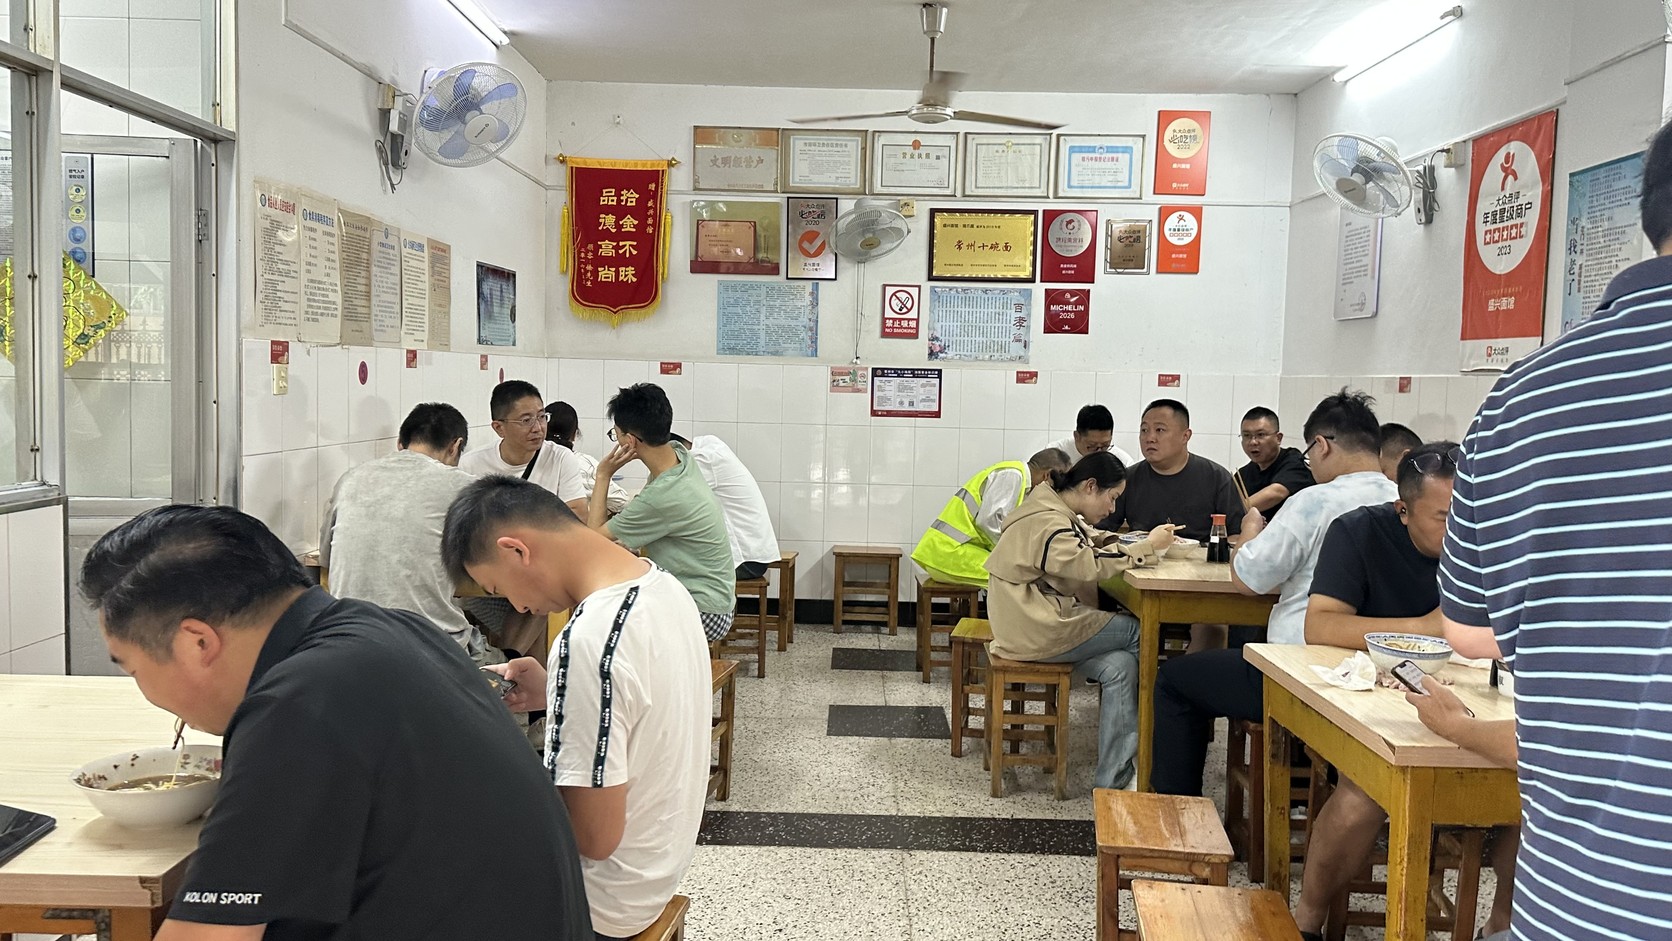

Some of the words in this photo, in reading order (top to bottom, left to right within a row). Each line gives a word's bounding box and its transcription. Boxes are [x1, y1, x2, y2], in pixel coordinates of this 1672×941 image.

[1495, 191, 1521, 208] 大众点评
[1482, 201, 1533, 226] 年度星级商户
[597, 188, 617, 283] 品德高尚
[618, 188, 640, 283] 拾金不昧
[954, 240, 1012, 252] 常州十碗面
[1496, 244, 1511, 257] 2023
[885, 319, 917, 328] 禁止吸烟
[1012, 303, 1027, 343] 百孝篇
[183, 892, 218, 903] KOLON
[219, 893, 262, 904] SPORT
